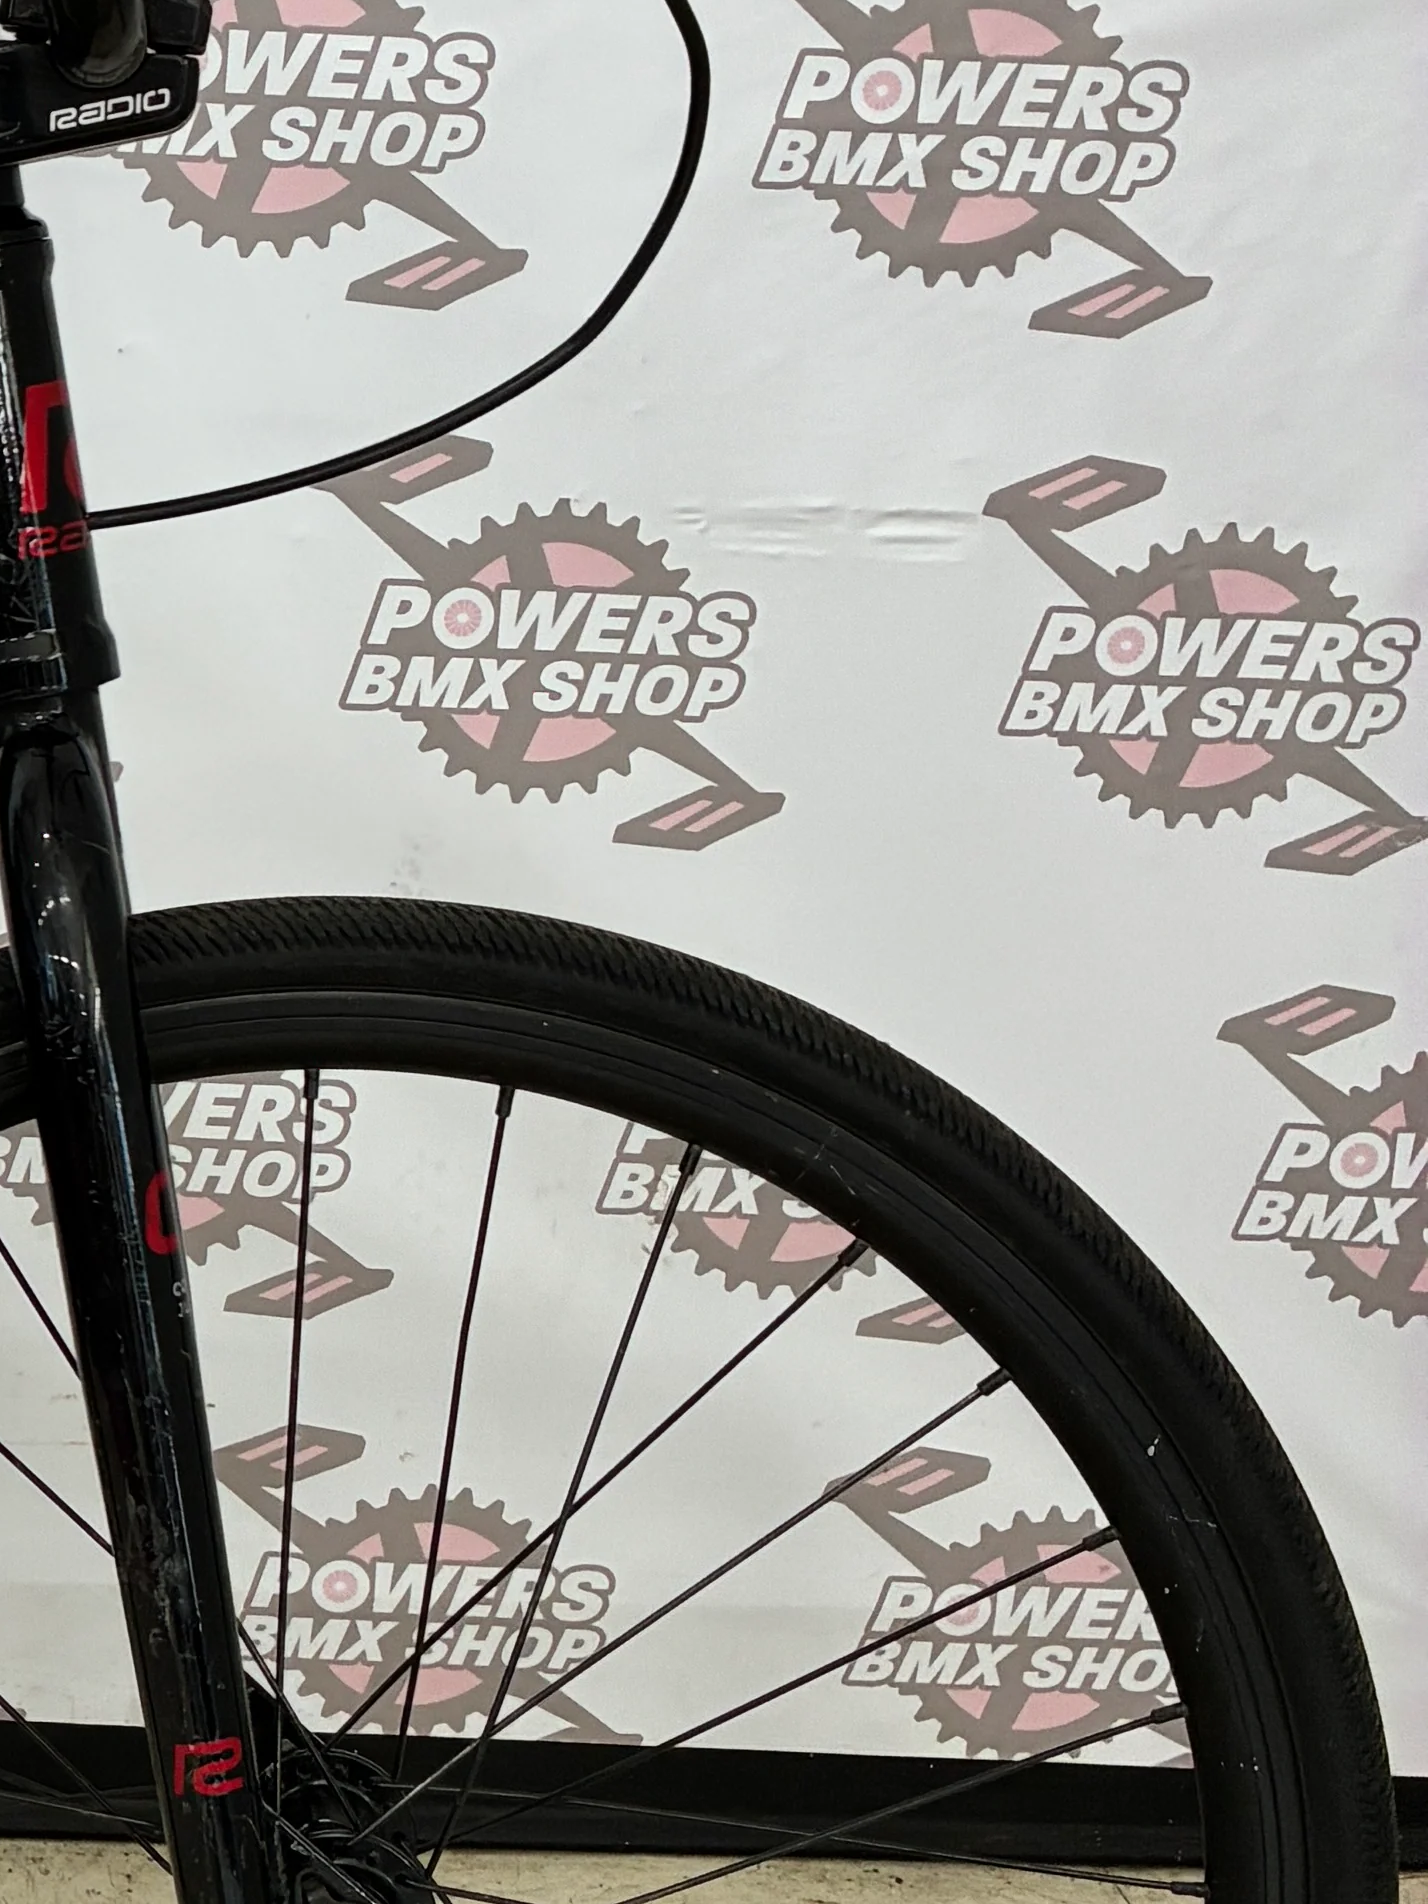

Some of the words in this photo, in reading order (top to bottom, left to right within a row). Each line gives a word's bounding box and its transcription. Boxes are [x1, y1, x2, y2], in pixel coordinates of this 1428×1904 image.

[206, 31, 491, 104] WERS
[783, 55, 1183, 132] POWERS
[263, 108, 482, 166] SHOP
[761, 128, 945, 188] BMX
[951, 137, 1170, 196] SHOP
[367, 584, 751, 658] POWERS
[1033, 612, 1412, 683] POWERS
[348, 652, 512, 707] BMX
[533, 660, 739, 718] SHOP
[1010, 681, 1172, 737] BMX
[1194, 687, 1396, 744] SHOP
[605, 1163, 758, 1217] BMX
[1238, 1190, 1417, 1244] BMX
[251, 1558, 610, 1622] POWERS
[872, 1584, 1156, 1641] POWE
[241, 1616, 388, 1662] BMX
[405, 1622, 604, 1672] SHOP
[847, 1639, 1007, 1687] BMX
[1022, 1646, 1174, 1694] SHO
